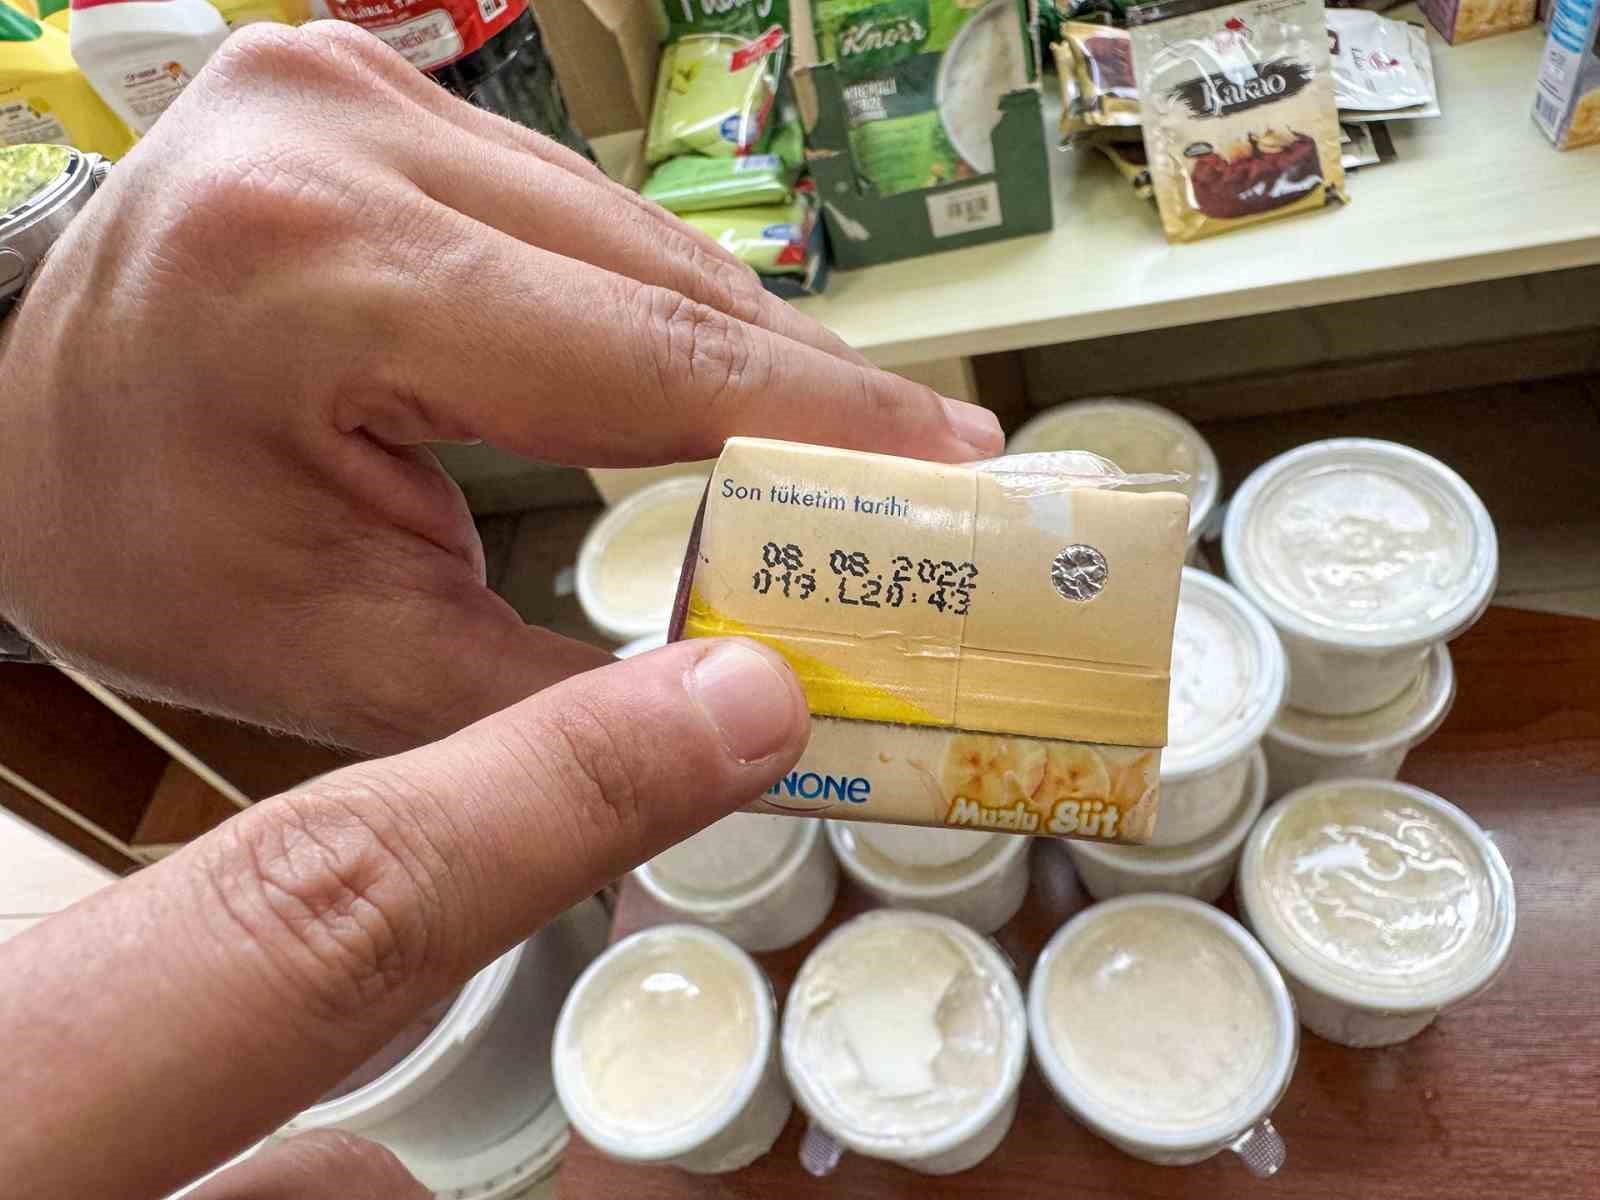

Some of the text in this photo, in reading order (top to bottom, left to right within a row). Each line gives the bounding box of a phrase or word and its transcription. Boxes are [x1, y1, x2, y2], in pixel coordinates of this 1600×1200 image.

[841, 19, 928, 56] Knorr
[1200, 74, 1287, 113] Kakao
[721, 478, 910, 517] Son tüketim tarihi
[767, 771, 871, 803] NONe
[947, 796, 1121, 839] Muzlu Süt
